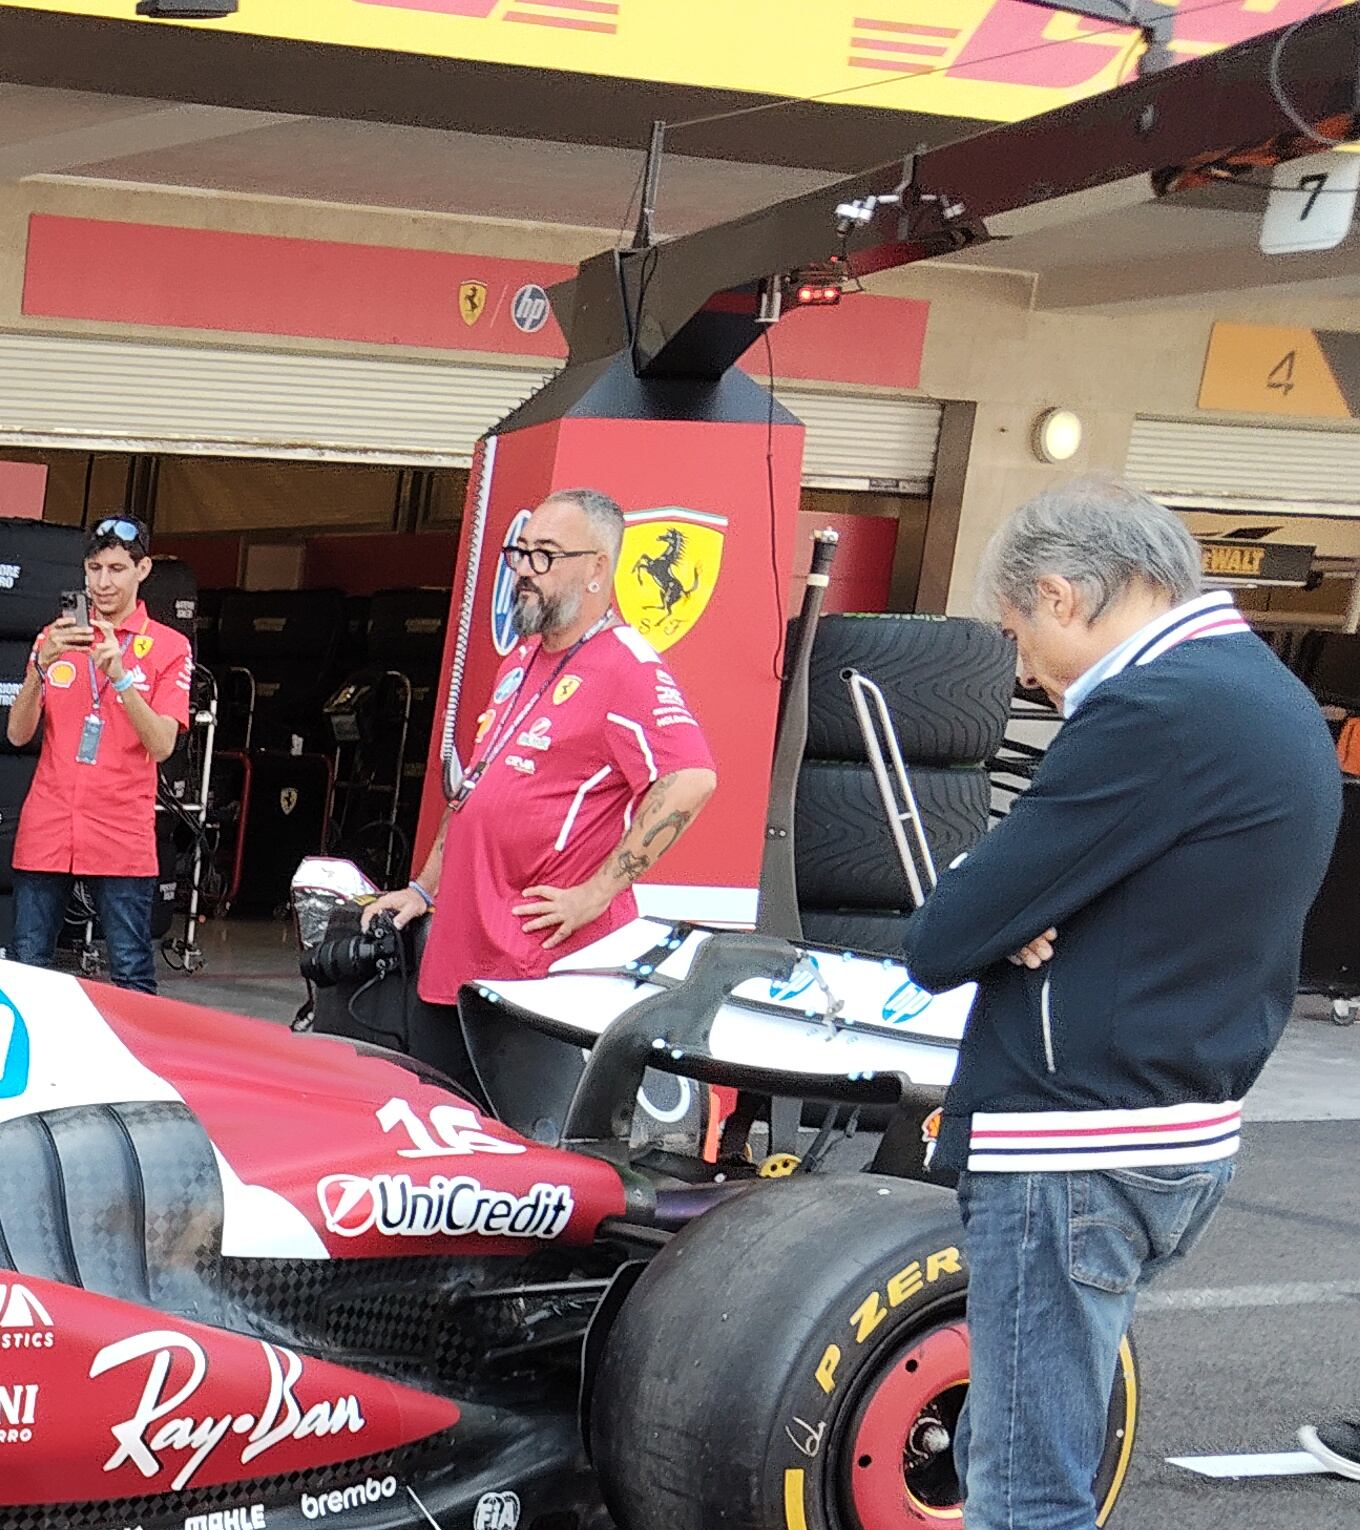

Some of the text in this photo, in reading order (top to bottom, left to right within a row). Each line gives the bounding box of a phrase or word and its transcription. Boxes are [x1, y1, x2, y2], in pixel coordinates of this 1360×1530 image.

[1300, 172, 1330, 221] 7
[1266, 349, 1298, 397] 4
[1200, 546, 1266, 576] EWALT
[375, 1097, 527, 1158] 16
[378, 1178, 569, 1235] UniCredit
[814, 1246, 963, 1394] P ZER
[301, 1475, 397, 1519] brembo
